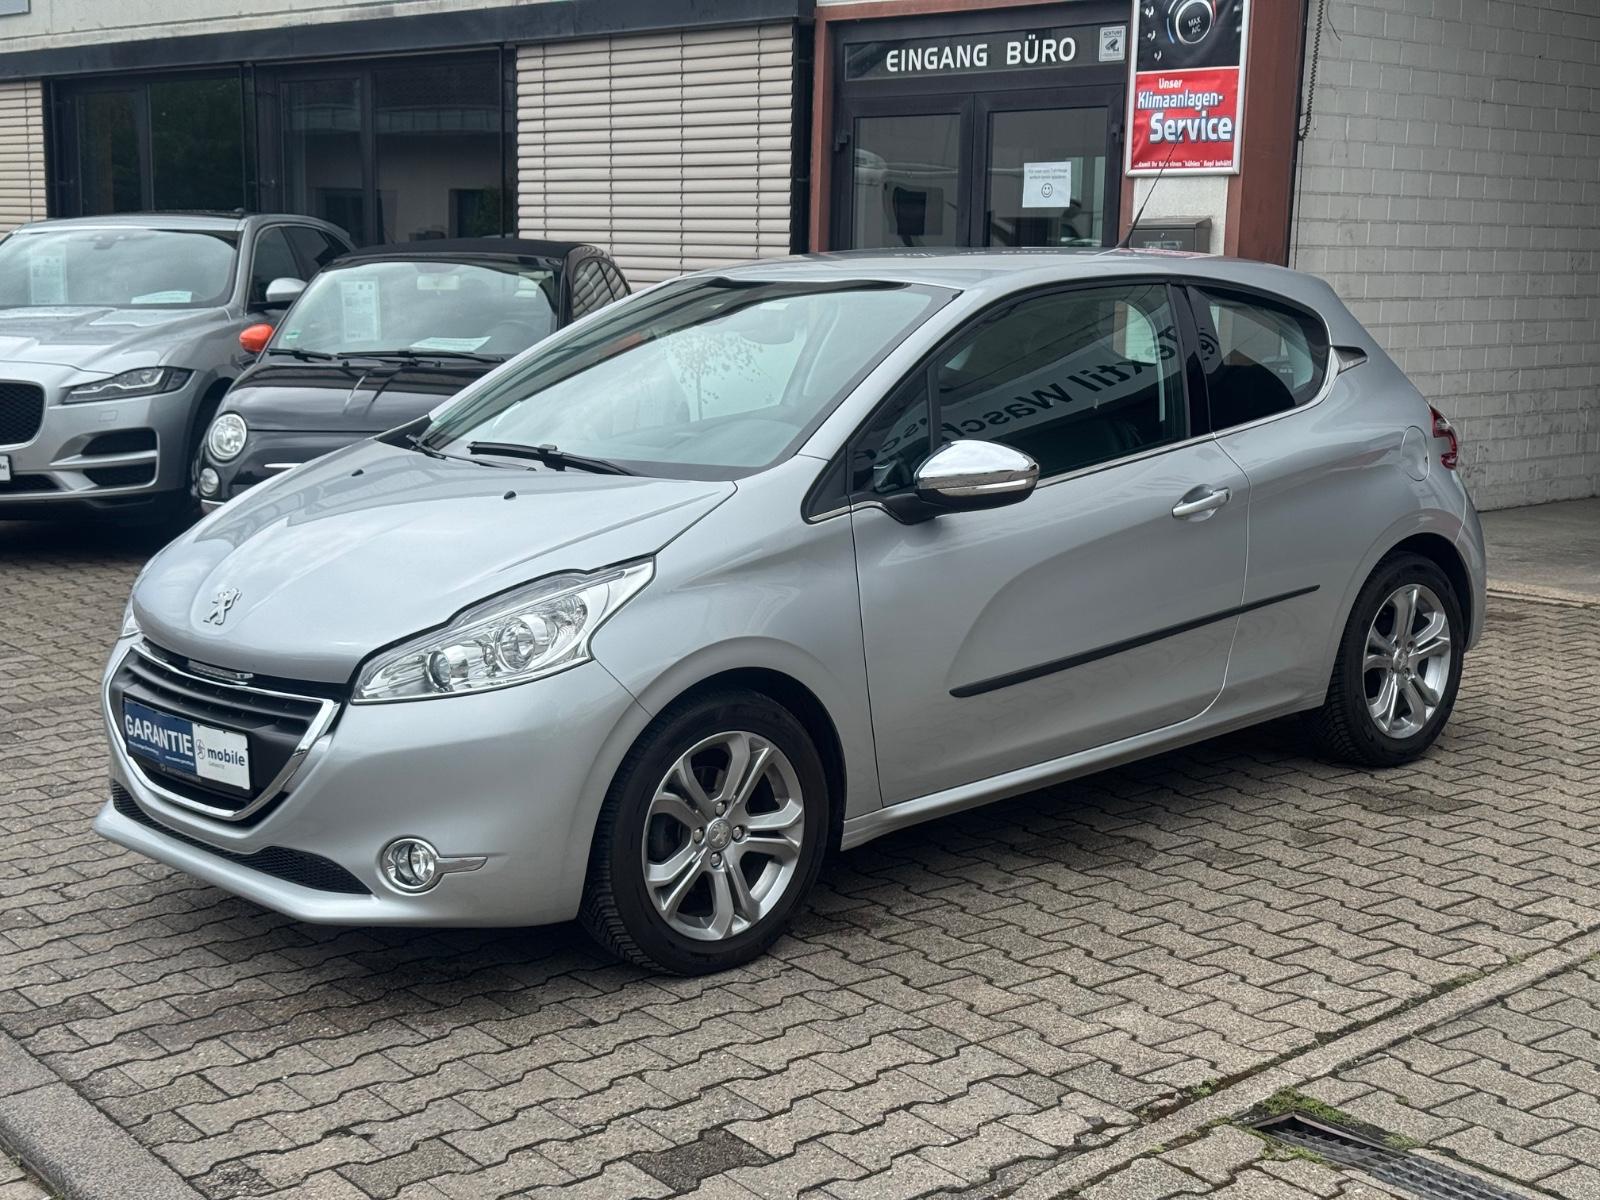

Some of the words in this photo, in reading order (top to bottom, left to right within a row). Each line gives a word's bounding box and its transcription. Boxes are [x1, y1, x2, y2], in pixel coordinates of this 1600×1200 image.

[1188, 16, 1202, 27] MAX
[1191, 24, 1201, 35] A/C
[886, 43, 988, 72] EINGANG
[1006, 34, 1077, 65] BÜRO
[1158, 78, 1183, 89] Unser
[1137, 89, 1224, 110] Klimaanlagen-
[1149, 111, 1232, 143] Service
[124, 714, 194, 757] GARANTIE
[207, 746, 246, 767] mobile
